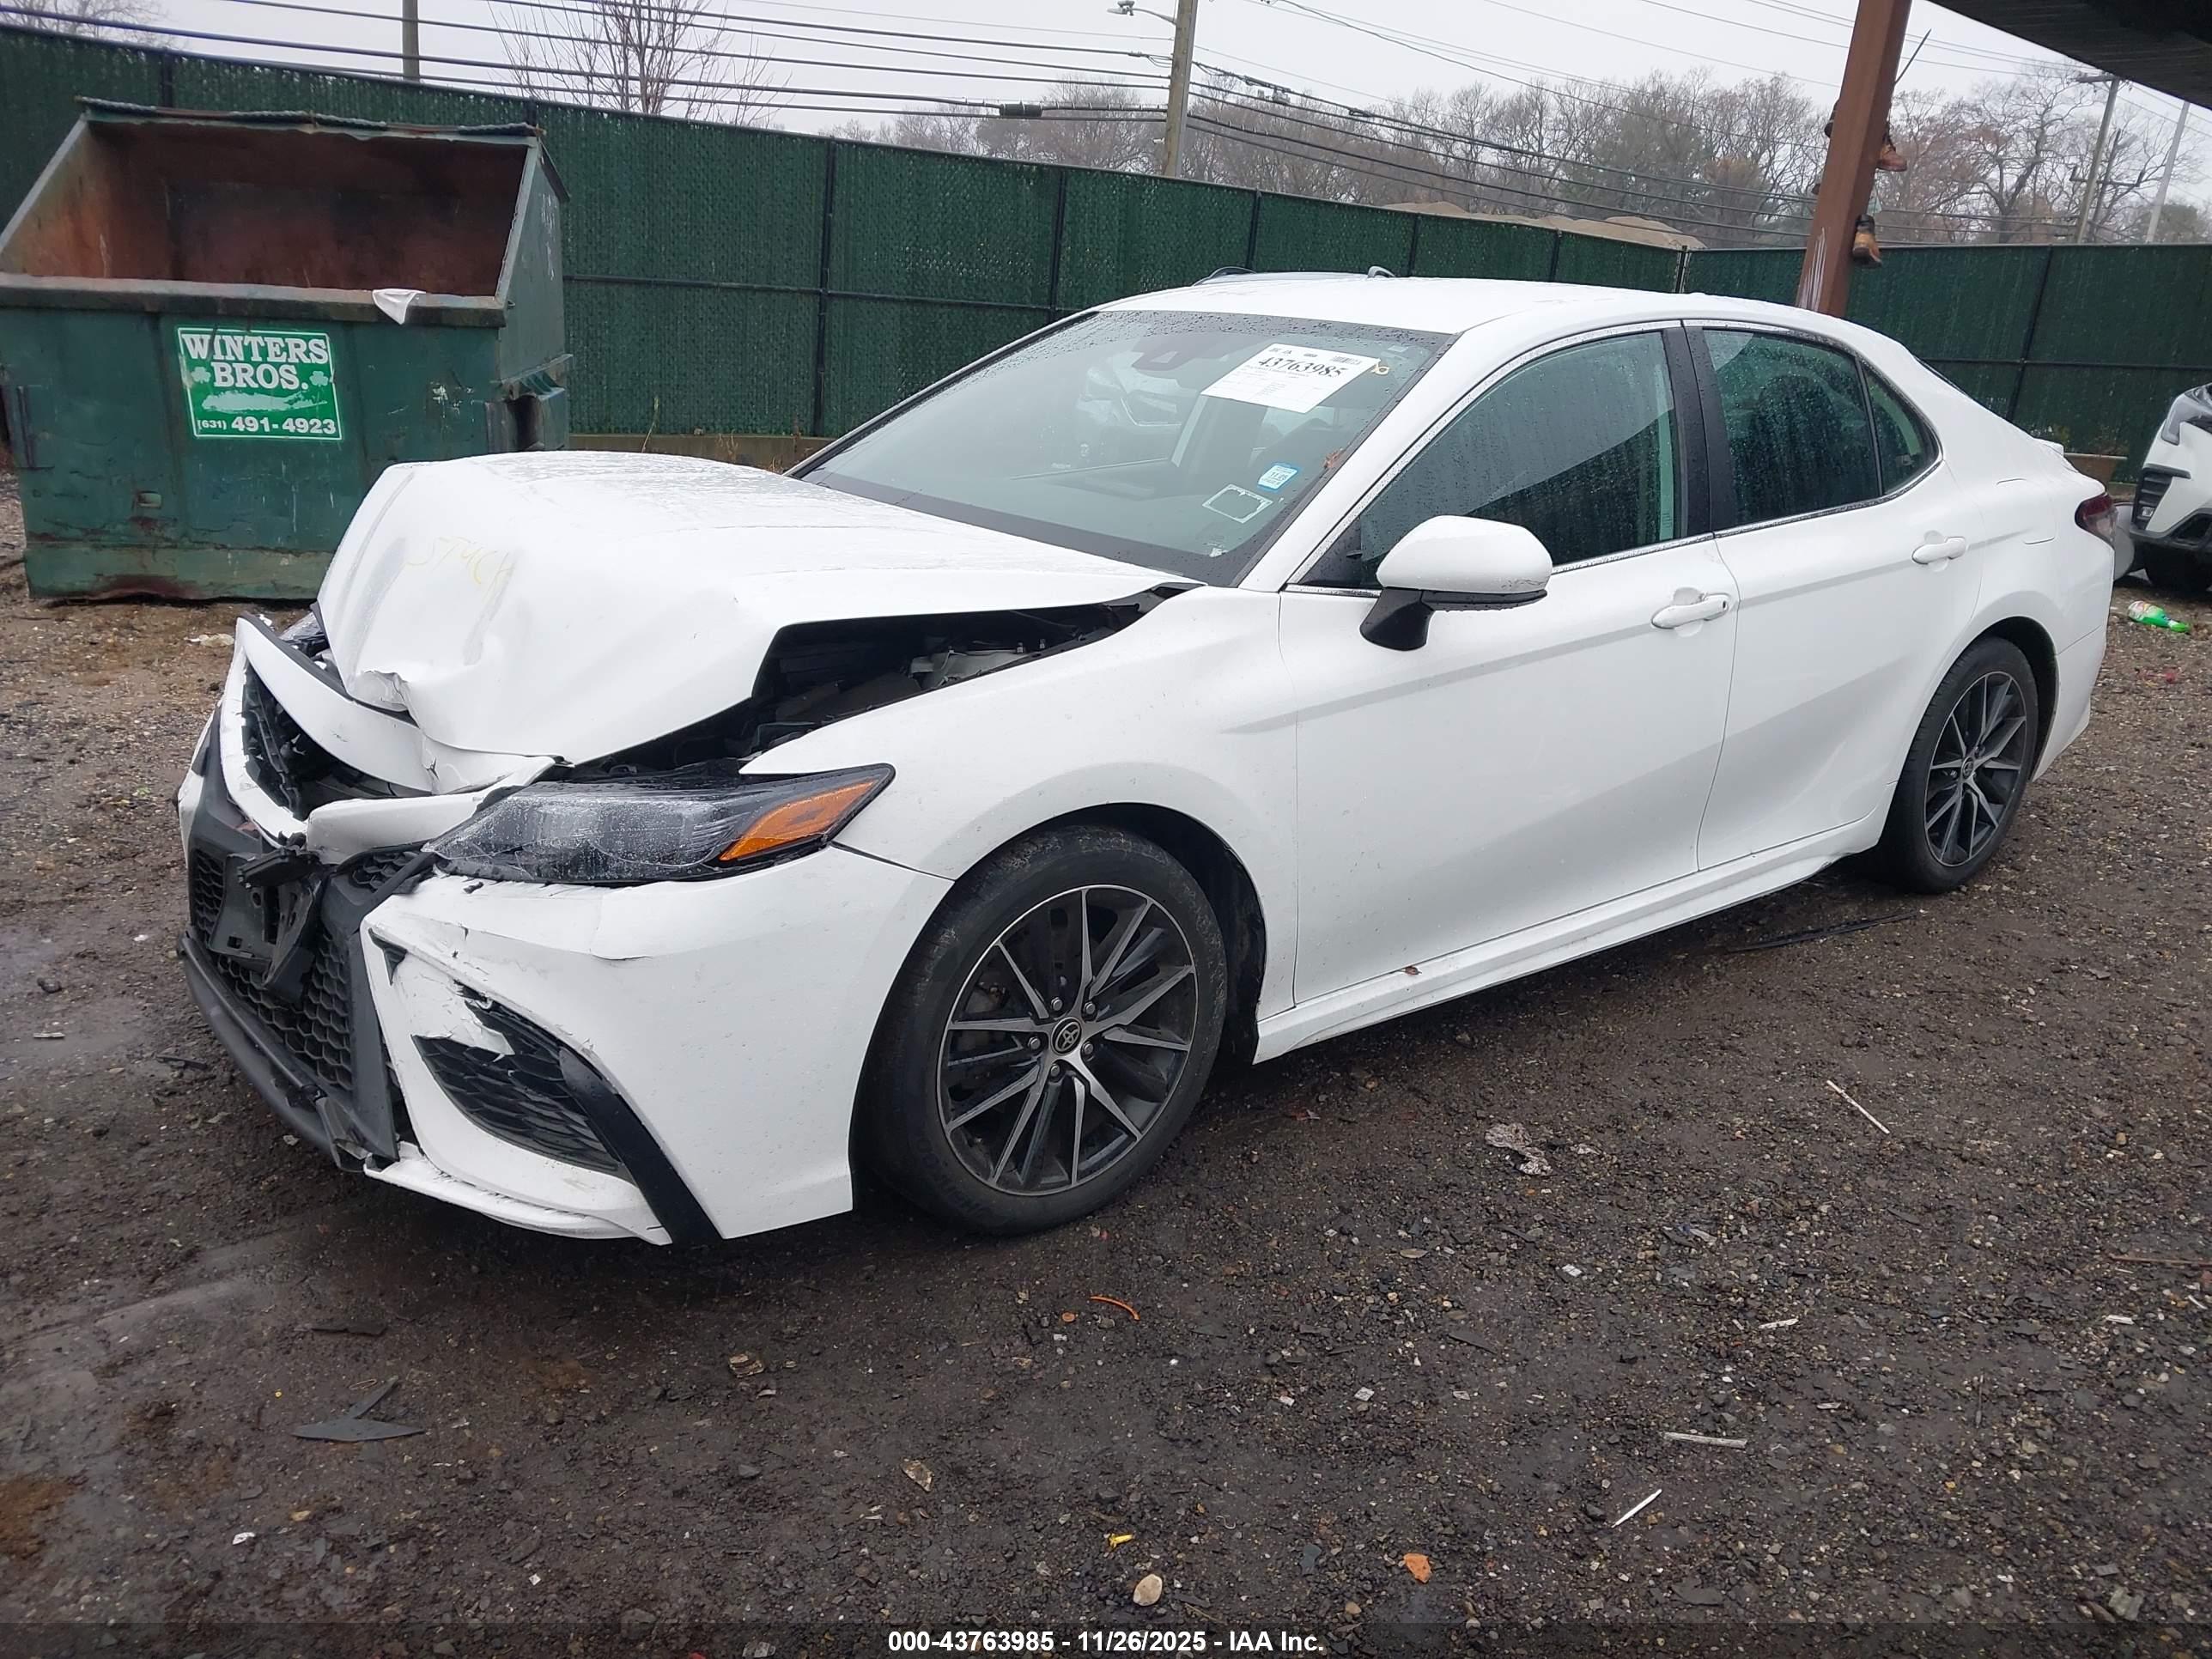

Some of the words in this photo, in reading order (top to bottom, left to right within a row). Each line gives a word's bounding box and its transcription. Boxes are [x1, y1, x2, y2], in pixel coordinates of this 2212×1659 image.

[182, 334, 329, 364] WINTERS
[212, 362, 308, 390] BROS.
[1258, 356, 1349, 377] 43763985
[198, 419, 227, 431] (631)
